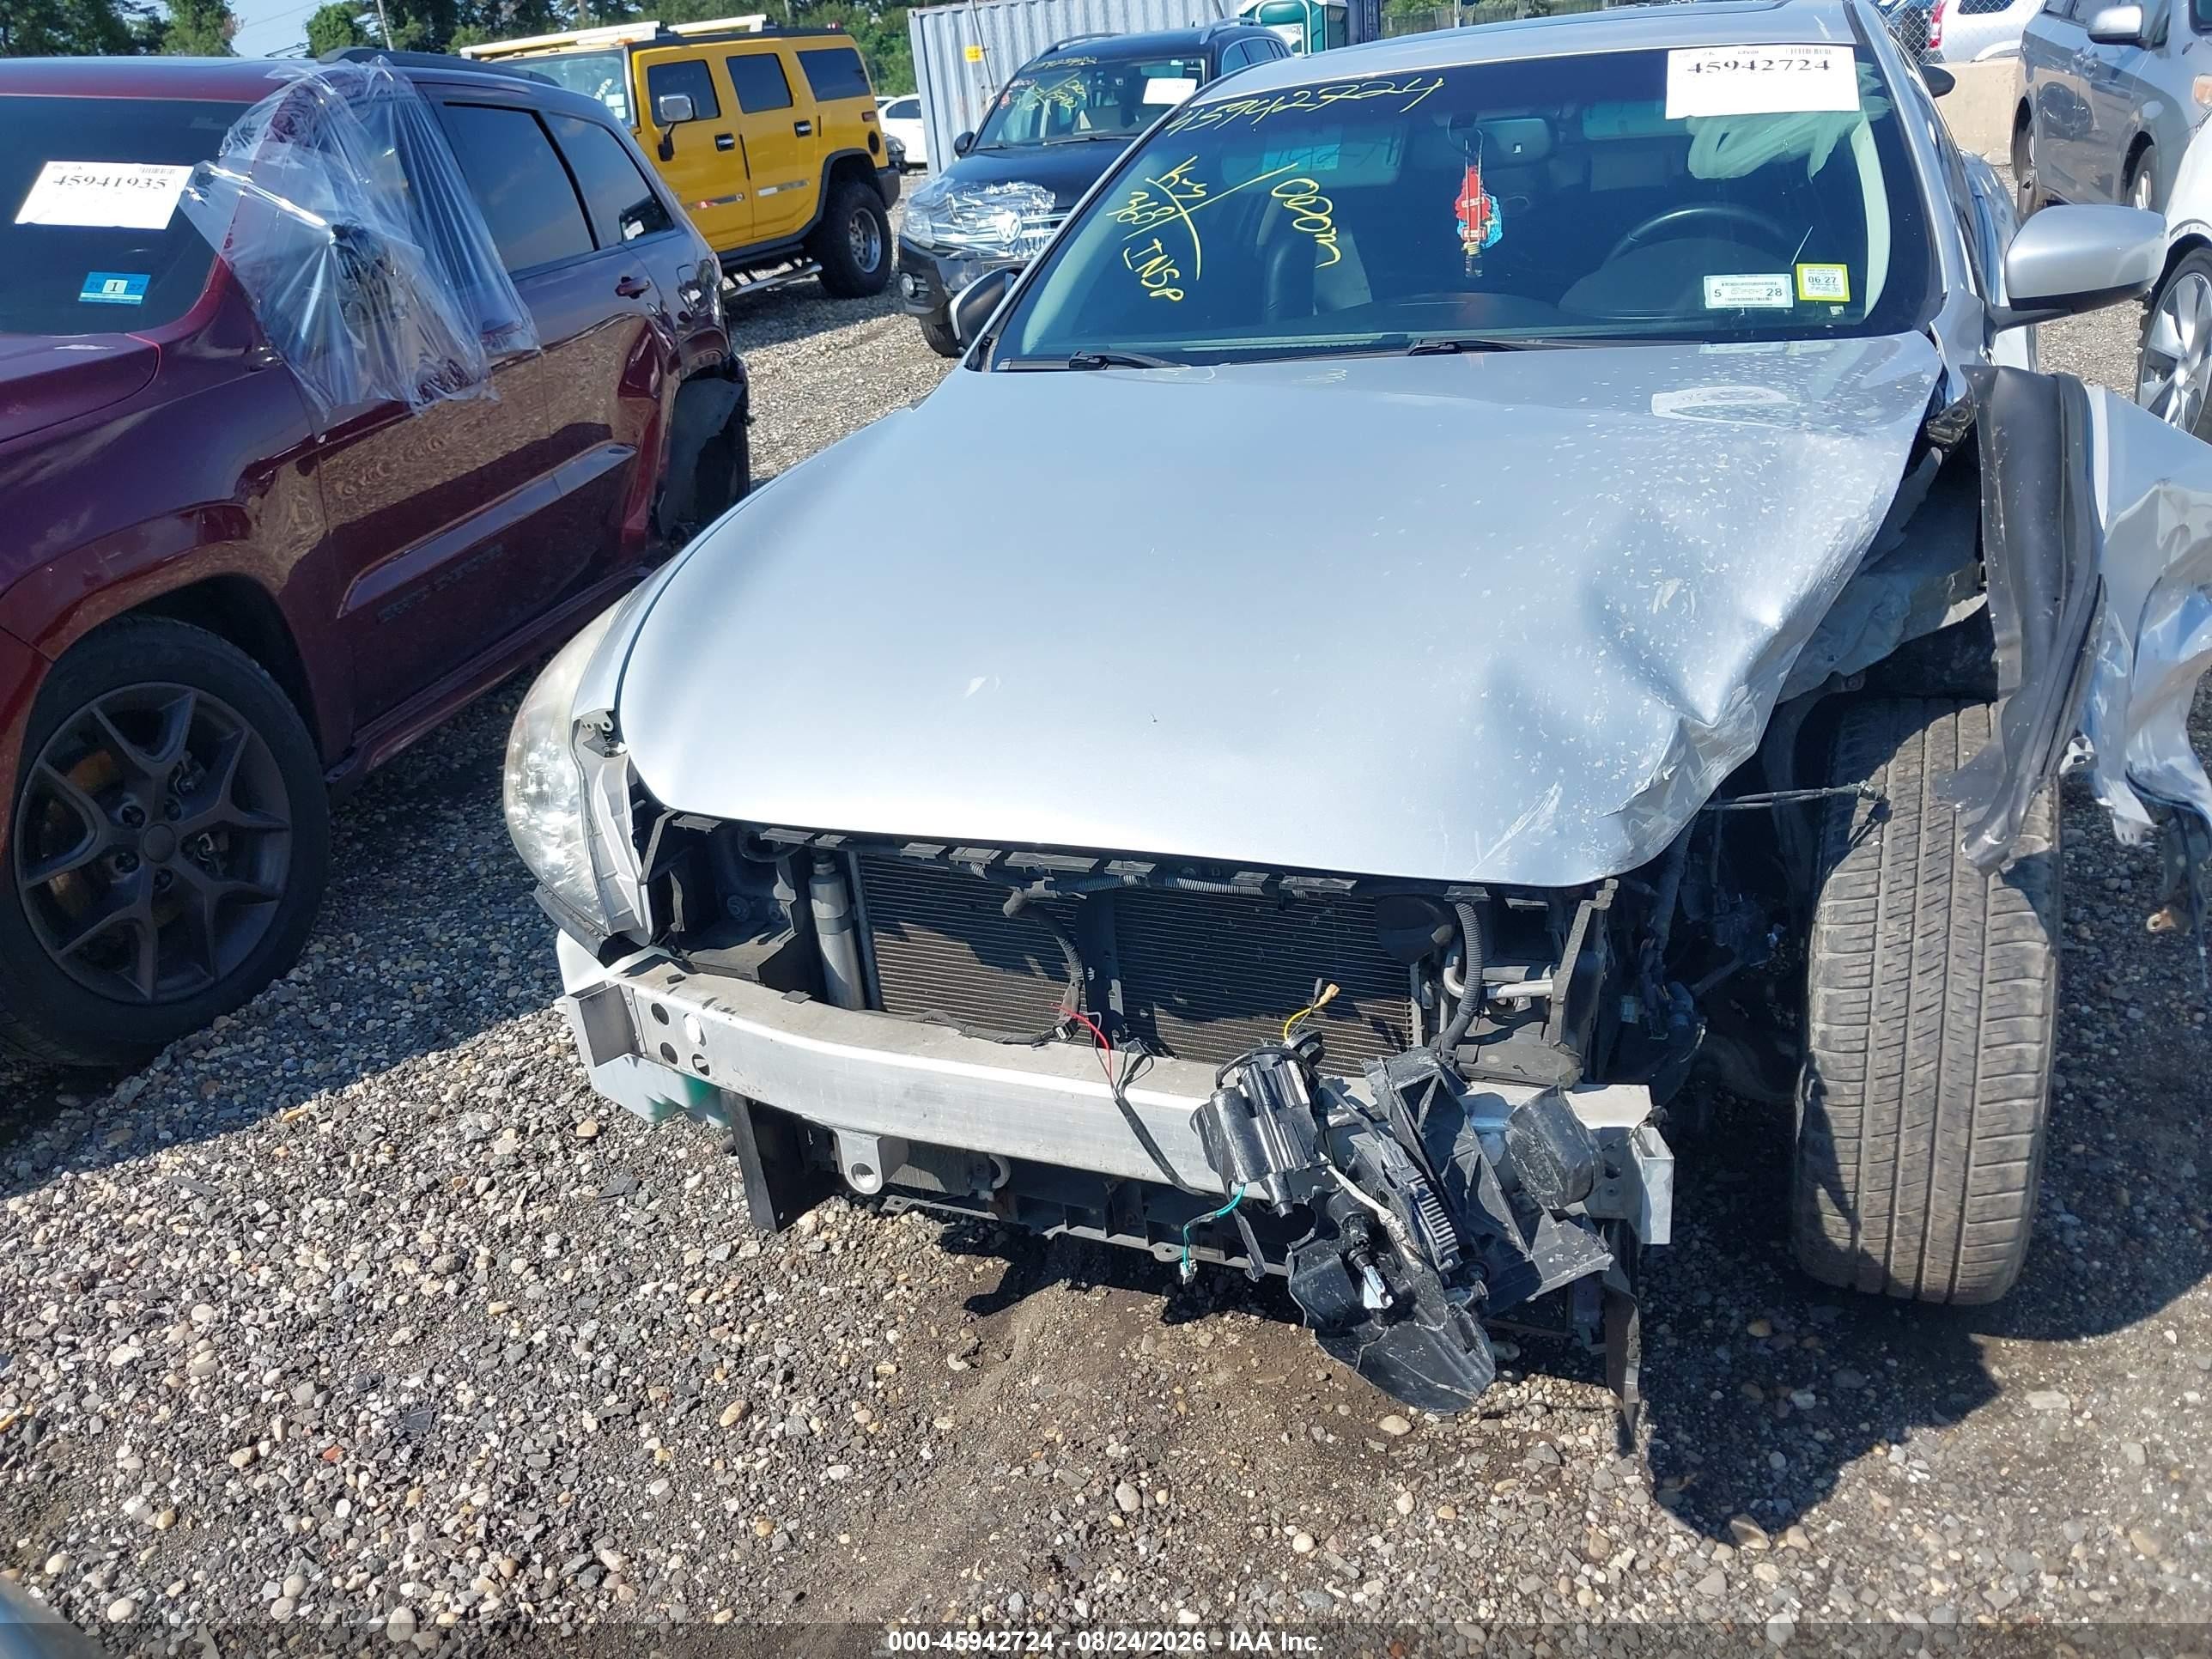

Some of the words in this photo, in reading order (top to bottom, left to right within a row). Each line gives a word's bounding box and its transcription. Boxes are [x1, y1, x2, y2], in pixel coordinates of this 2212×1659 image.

[1686, 58, 1831, 74] 45942724
[1164, 77, 1444, 137] 45942724
[52, 174, 168, 190] 45941935
[109, 281, 118, 292] 1
[1714, 289, 1722, 297] 5
[1765, 288, 1783, 297] 28
